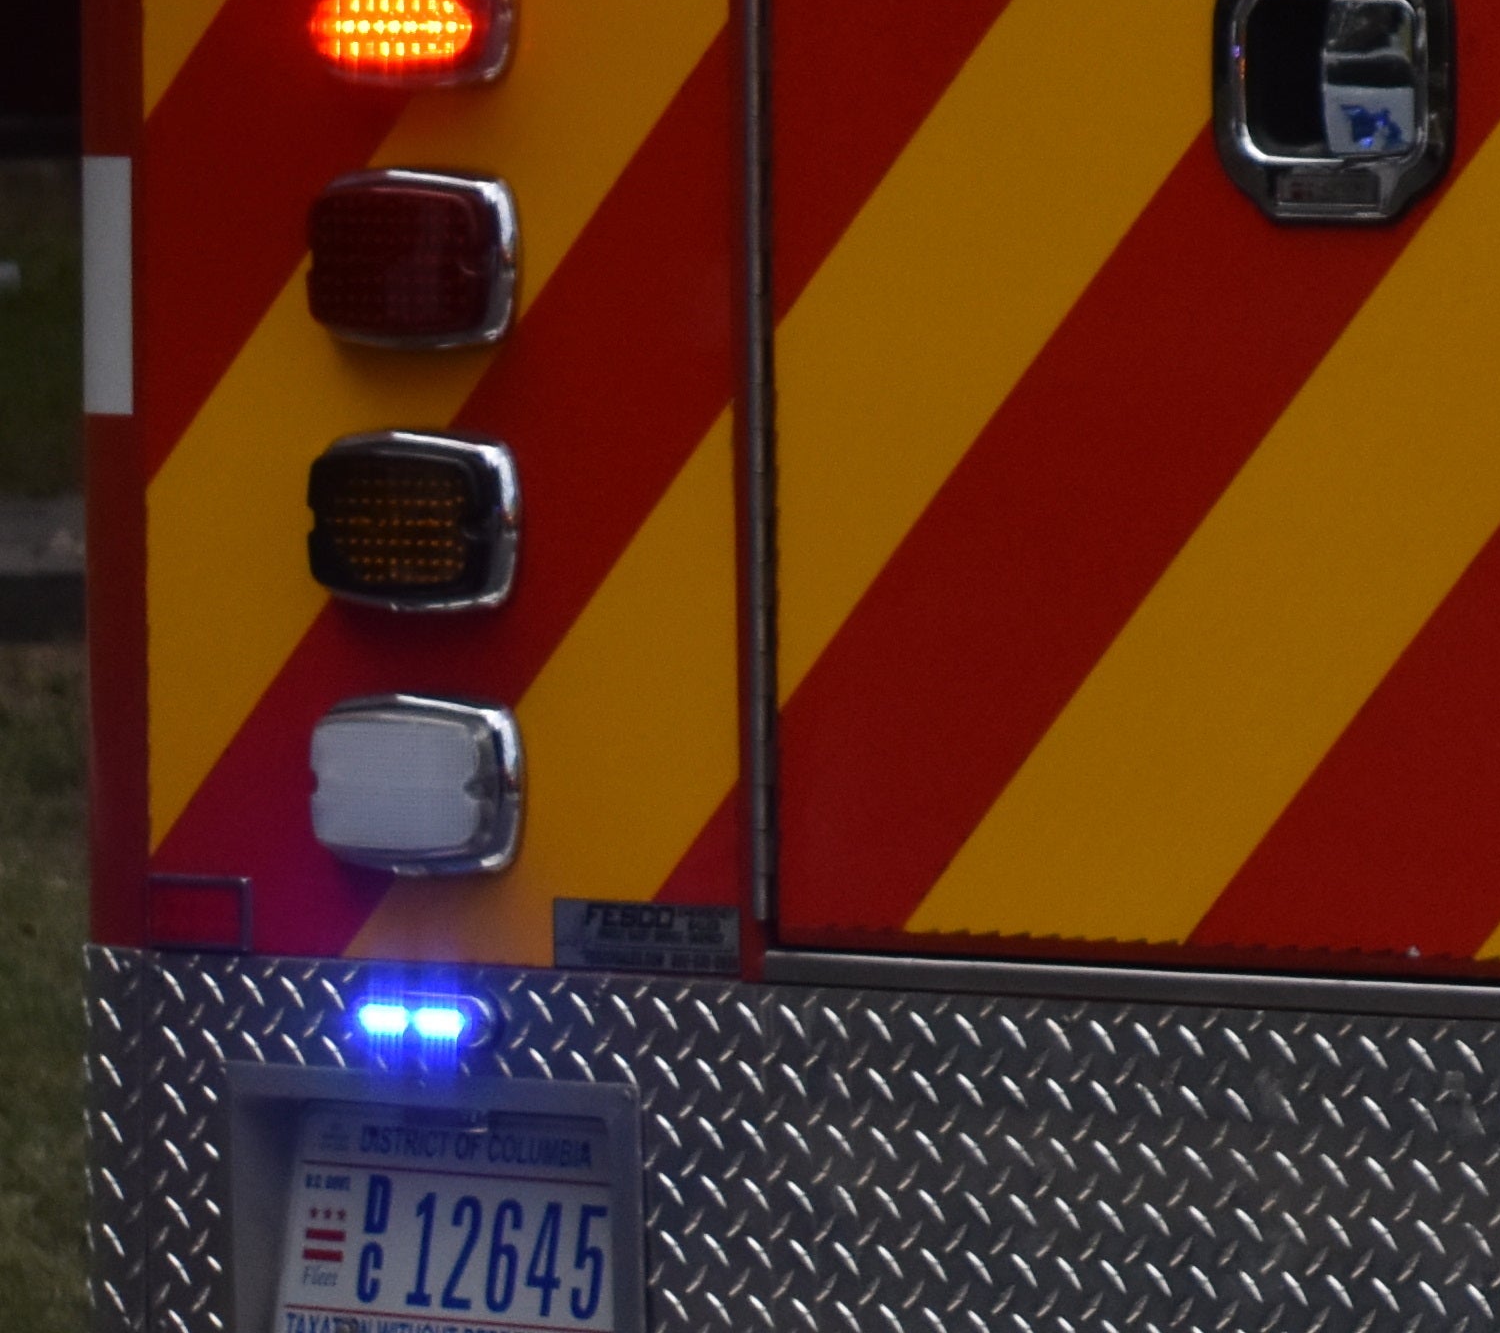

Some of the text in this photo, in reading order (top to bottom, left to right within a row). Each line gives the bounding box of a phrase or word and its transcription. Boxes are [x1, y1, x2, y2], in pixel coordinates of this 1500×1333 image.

[360, 1126, 592, 1168] DISTRICT OF COLUMBIA
[405, 1192, 608, 1321] 12645
